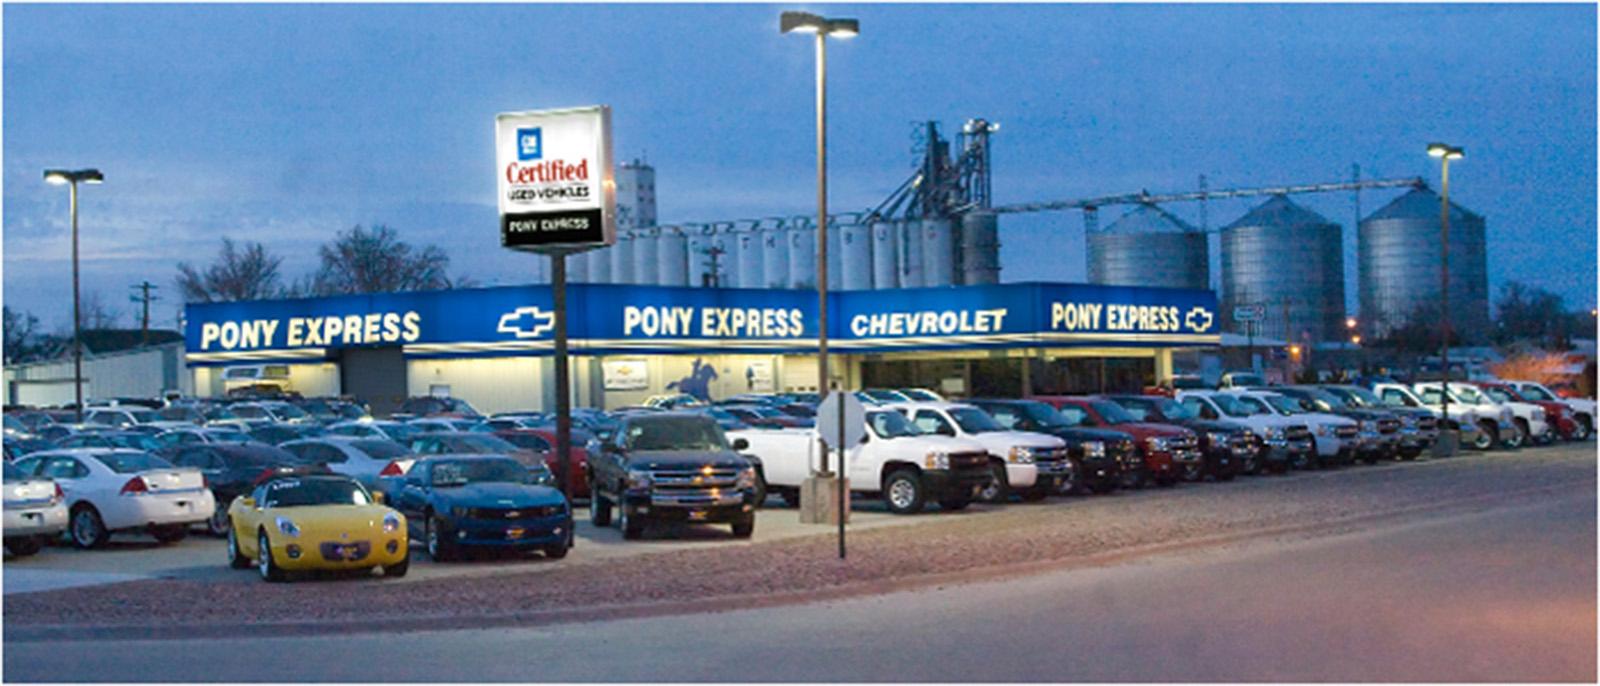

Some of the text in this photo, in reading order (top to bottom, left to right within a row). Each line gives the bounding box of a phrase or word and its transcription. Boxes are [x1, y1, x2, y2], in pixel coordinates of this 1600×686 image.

[506, 158, 589, 184] Certified
[509, 218, 590, 232] PONY EXPRESS
[200, 311, 421, 350] PONY EXPRESS
[623, 306, 804, 337] PONY EXPRESS
[850, 308, 1008, 337] CHEVROLET
[1051, 302, 1180, 332] PONY EXPRESS
